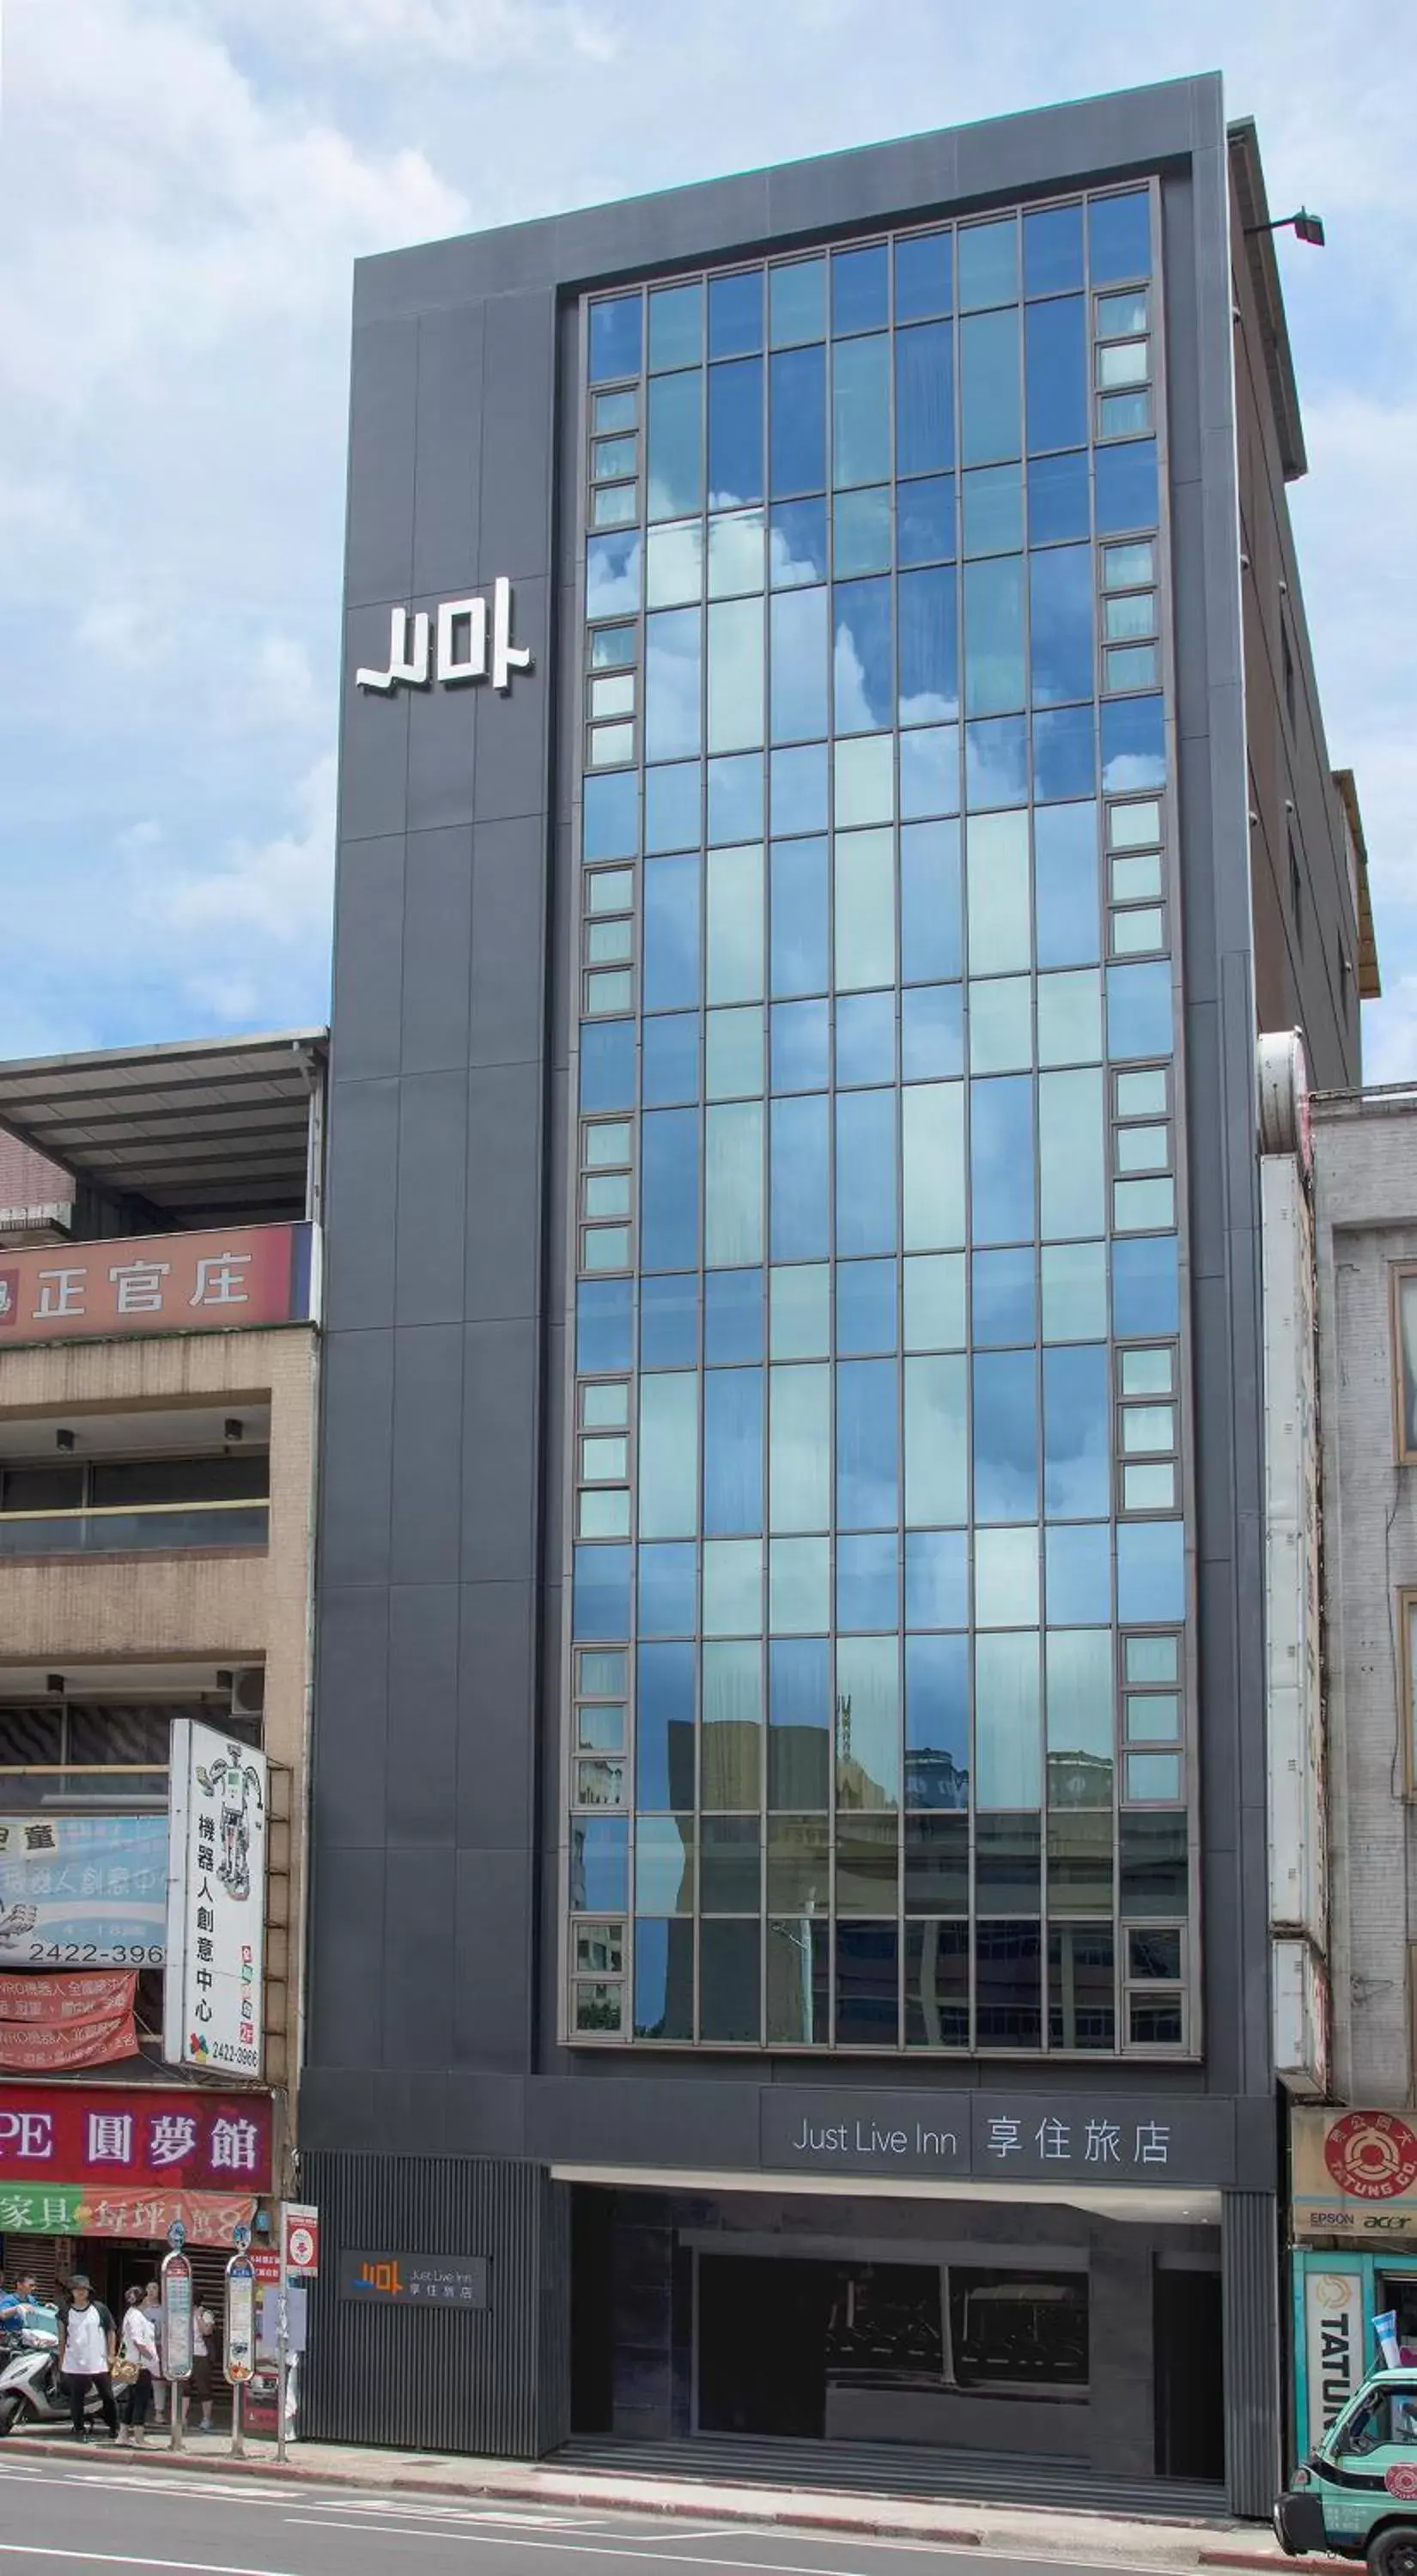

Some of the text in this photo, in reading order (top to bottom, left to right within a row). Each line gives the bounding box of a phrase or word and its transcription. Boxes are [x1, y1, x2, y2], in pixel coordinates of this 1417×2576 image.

[32, 1252, 252, 1319] 正官庄
[196, 1814, 216, 2022] 機器人創意中心
[29, 1943, 167, 1964] 2422-396
[88, 2113, 257, 2170] 圓夢館
[794, 2116, 1171, 2164] Just Live Inn 享住旅店
[1331, 2160, 1393, 2196] TATUNG
[0, 2195, 71, 2230] 家具
[1311, 2213, 1412, 2229] EPSON acer
